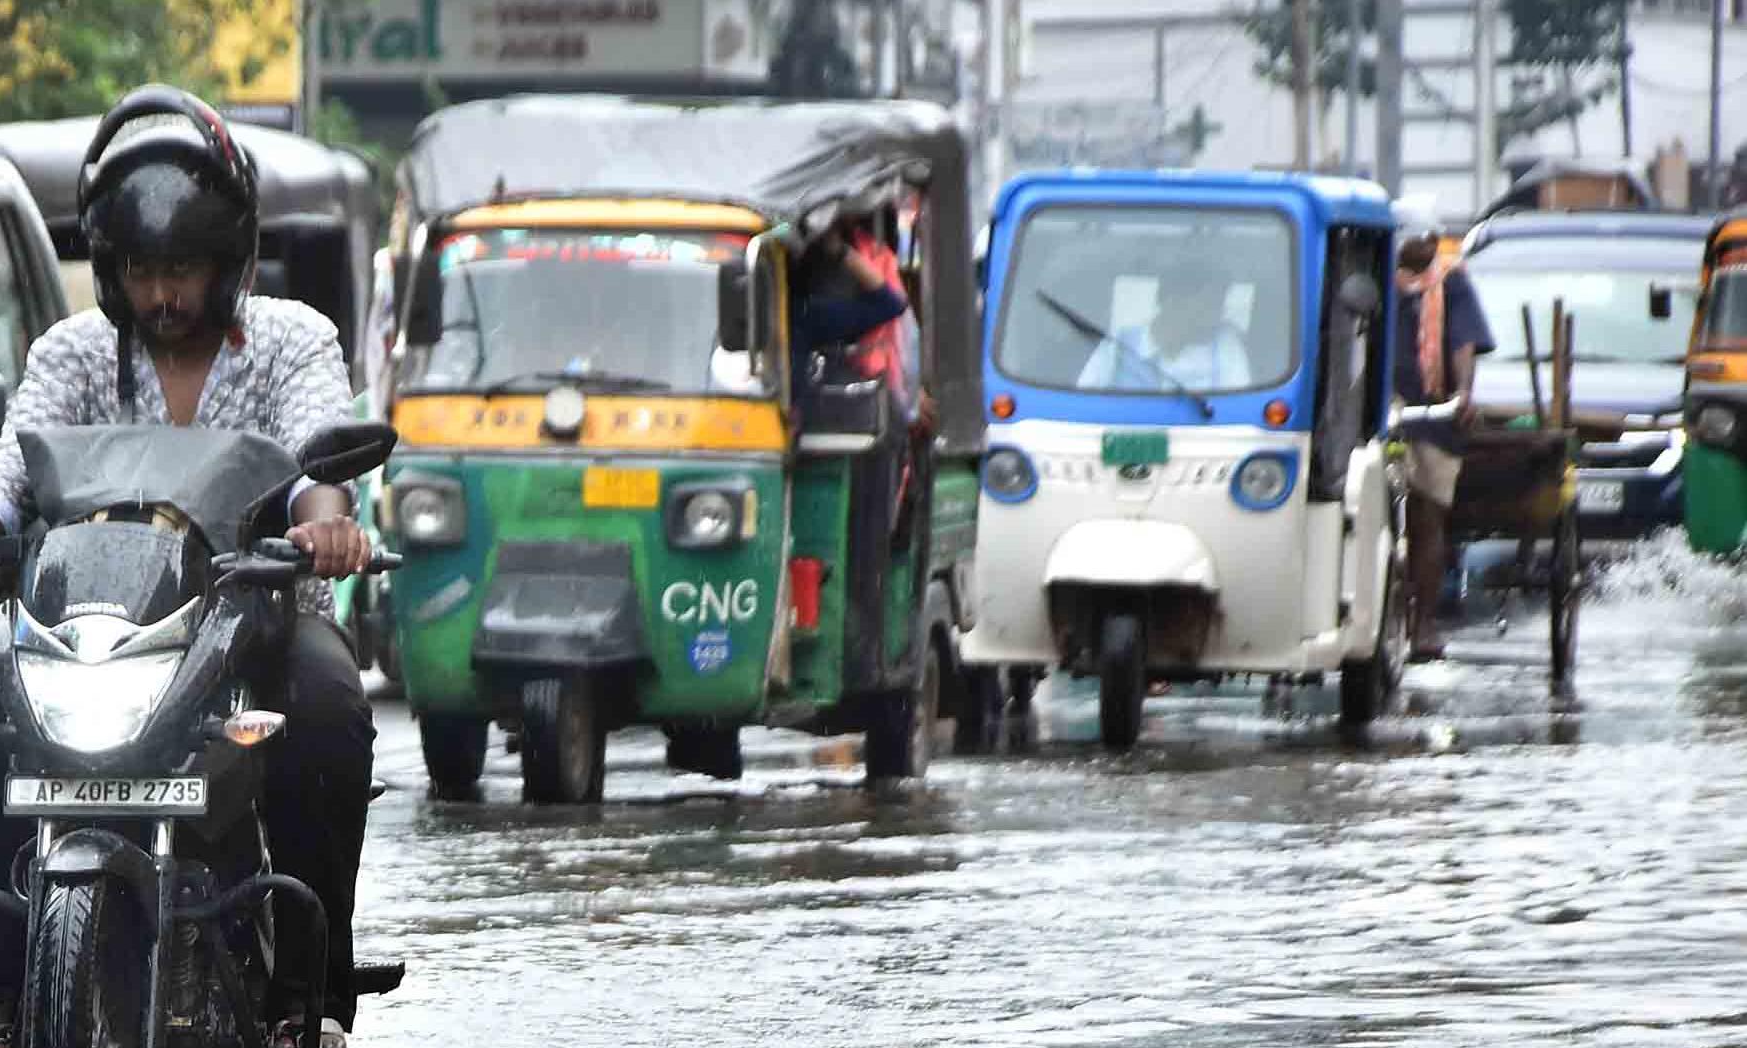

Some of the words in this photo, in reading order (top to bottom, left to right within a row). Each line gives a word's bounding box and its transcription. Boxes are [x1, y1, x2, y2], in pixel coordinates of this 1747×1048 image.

[65, 601, 129, 615] HONDA
[661, 579, 758, 623] CNG
[35, 780, 64, 803] AP
[74, 780, 133, 803] 40FB
[143, 780, 201, 803] 2735
